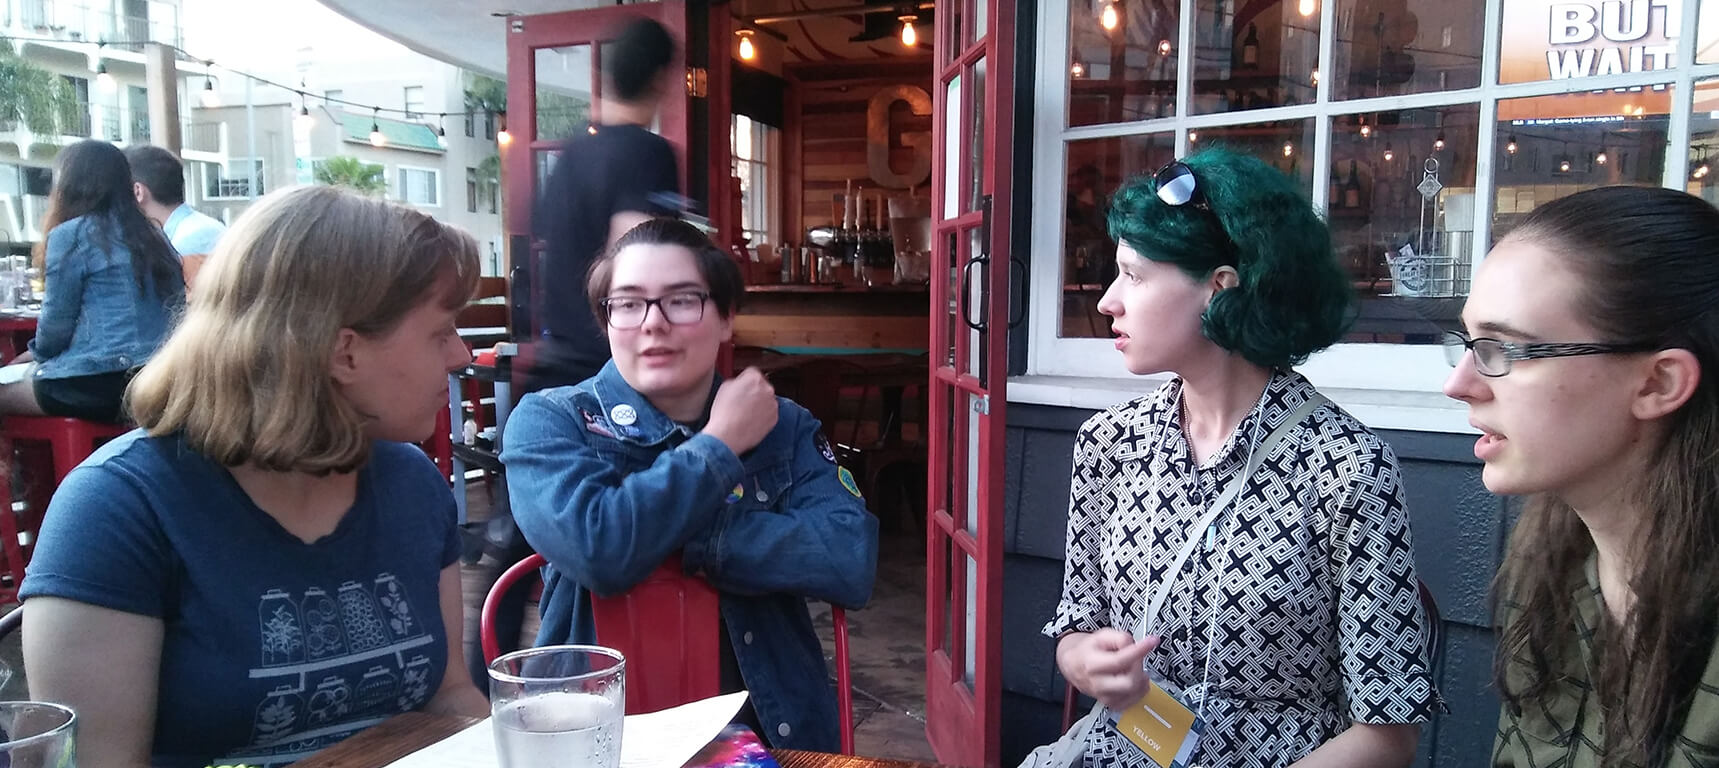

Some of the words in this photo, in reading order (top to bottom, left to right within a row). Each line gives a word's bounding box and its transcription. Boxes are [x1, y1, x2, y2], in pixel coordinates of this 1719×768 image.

[1549, 0, 1683, 44] BUT
[1547, 45, 1678, 93] WAIT
[867, 85, 933, 190] G
[1133, 725, 1161, 751] YELLOW
